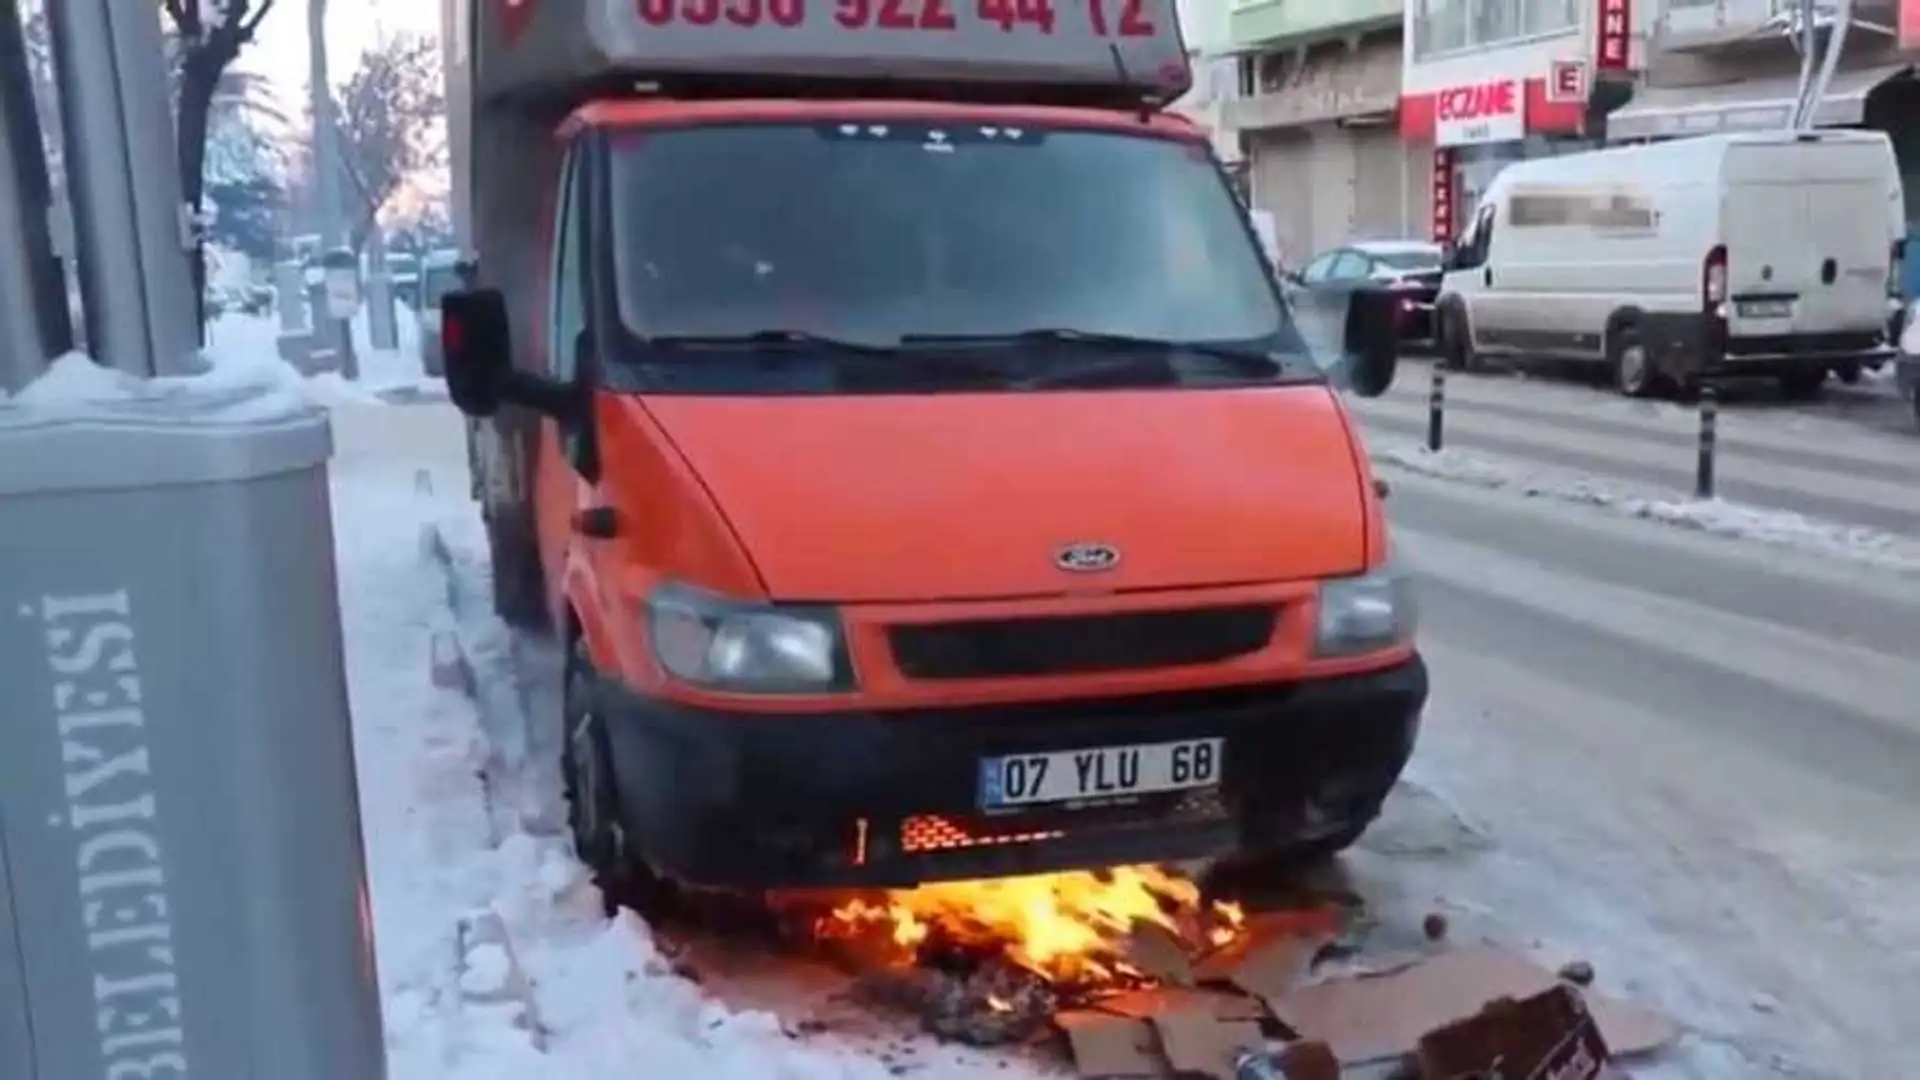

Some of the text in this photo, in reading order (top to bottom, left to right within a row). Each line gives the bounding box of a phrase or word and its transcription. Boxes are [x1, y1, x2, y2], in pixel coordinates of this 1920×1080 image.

[1558, 69, 1579, 92] E
[1005, 757, 1050, 798] 07
[1074, 749, 1141, 793] YLU
[1171, 742, 1212, 783] 68
[17, 588, 188, 1080] BELEDİYESİ
